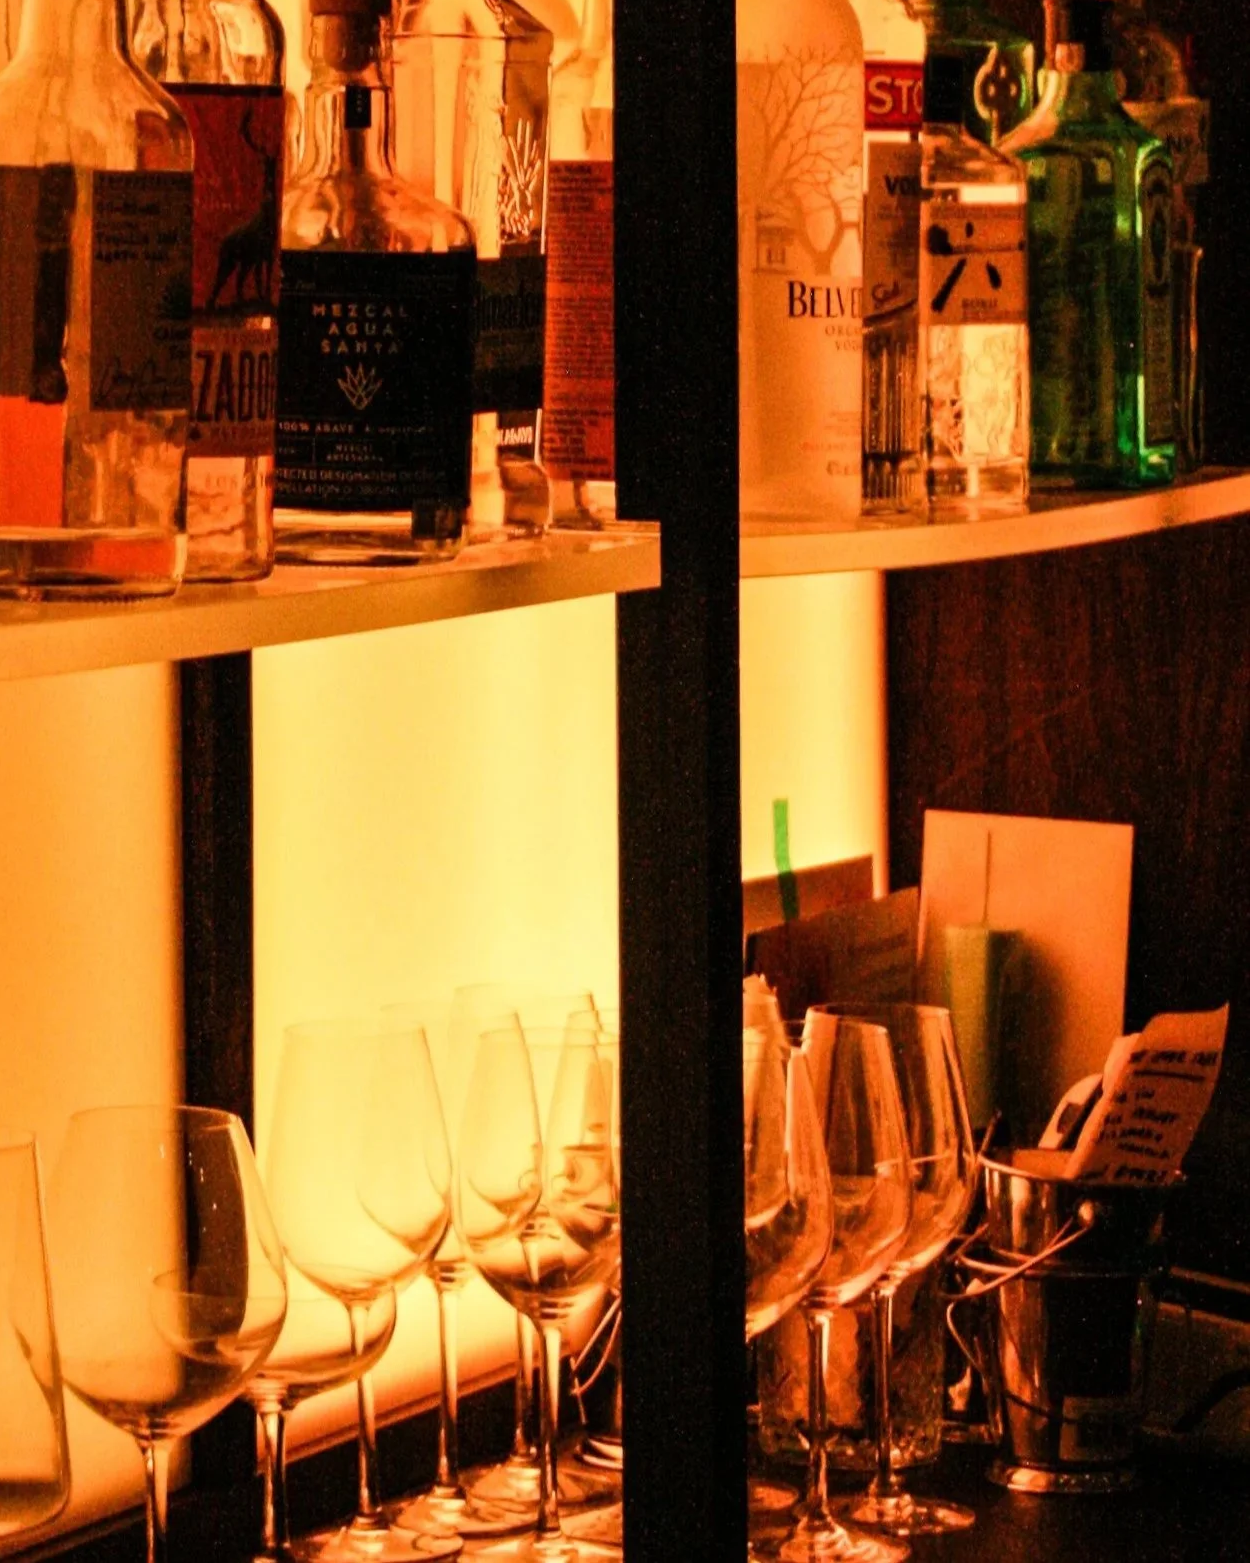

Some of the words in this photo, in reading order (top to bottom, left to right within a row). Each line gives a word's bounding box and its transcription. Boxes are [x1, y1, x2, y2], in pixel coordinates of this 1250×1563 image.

[311, 301, 409, 319] MEZCAL
[328, 321, 395, 337] AGUA
[320, 339, 400, 356] SANTA
